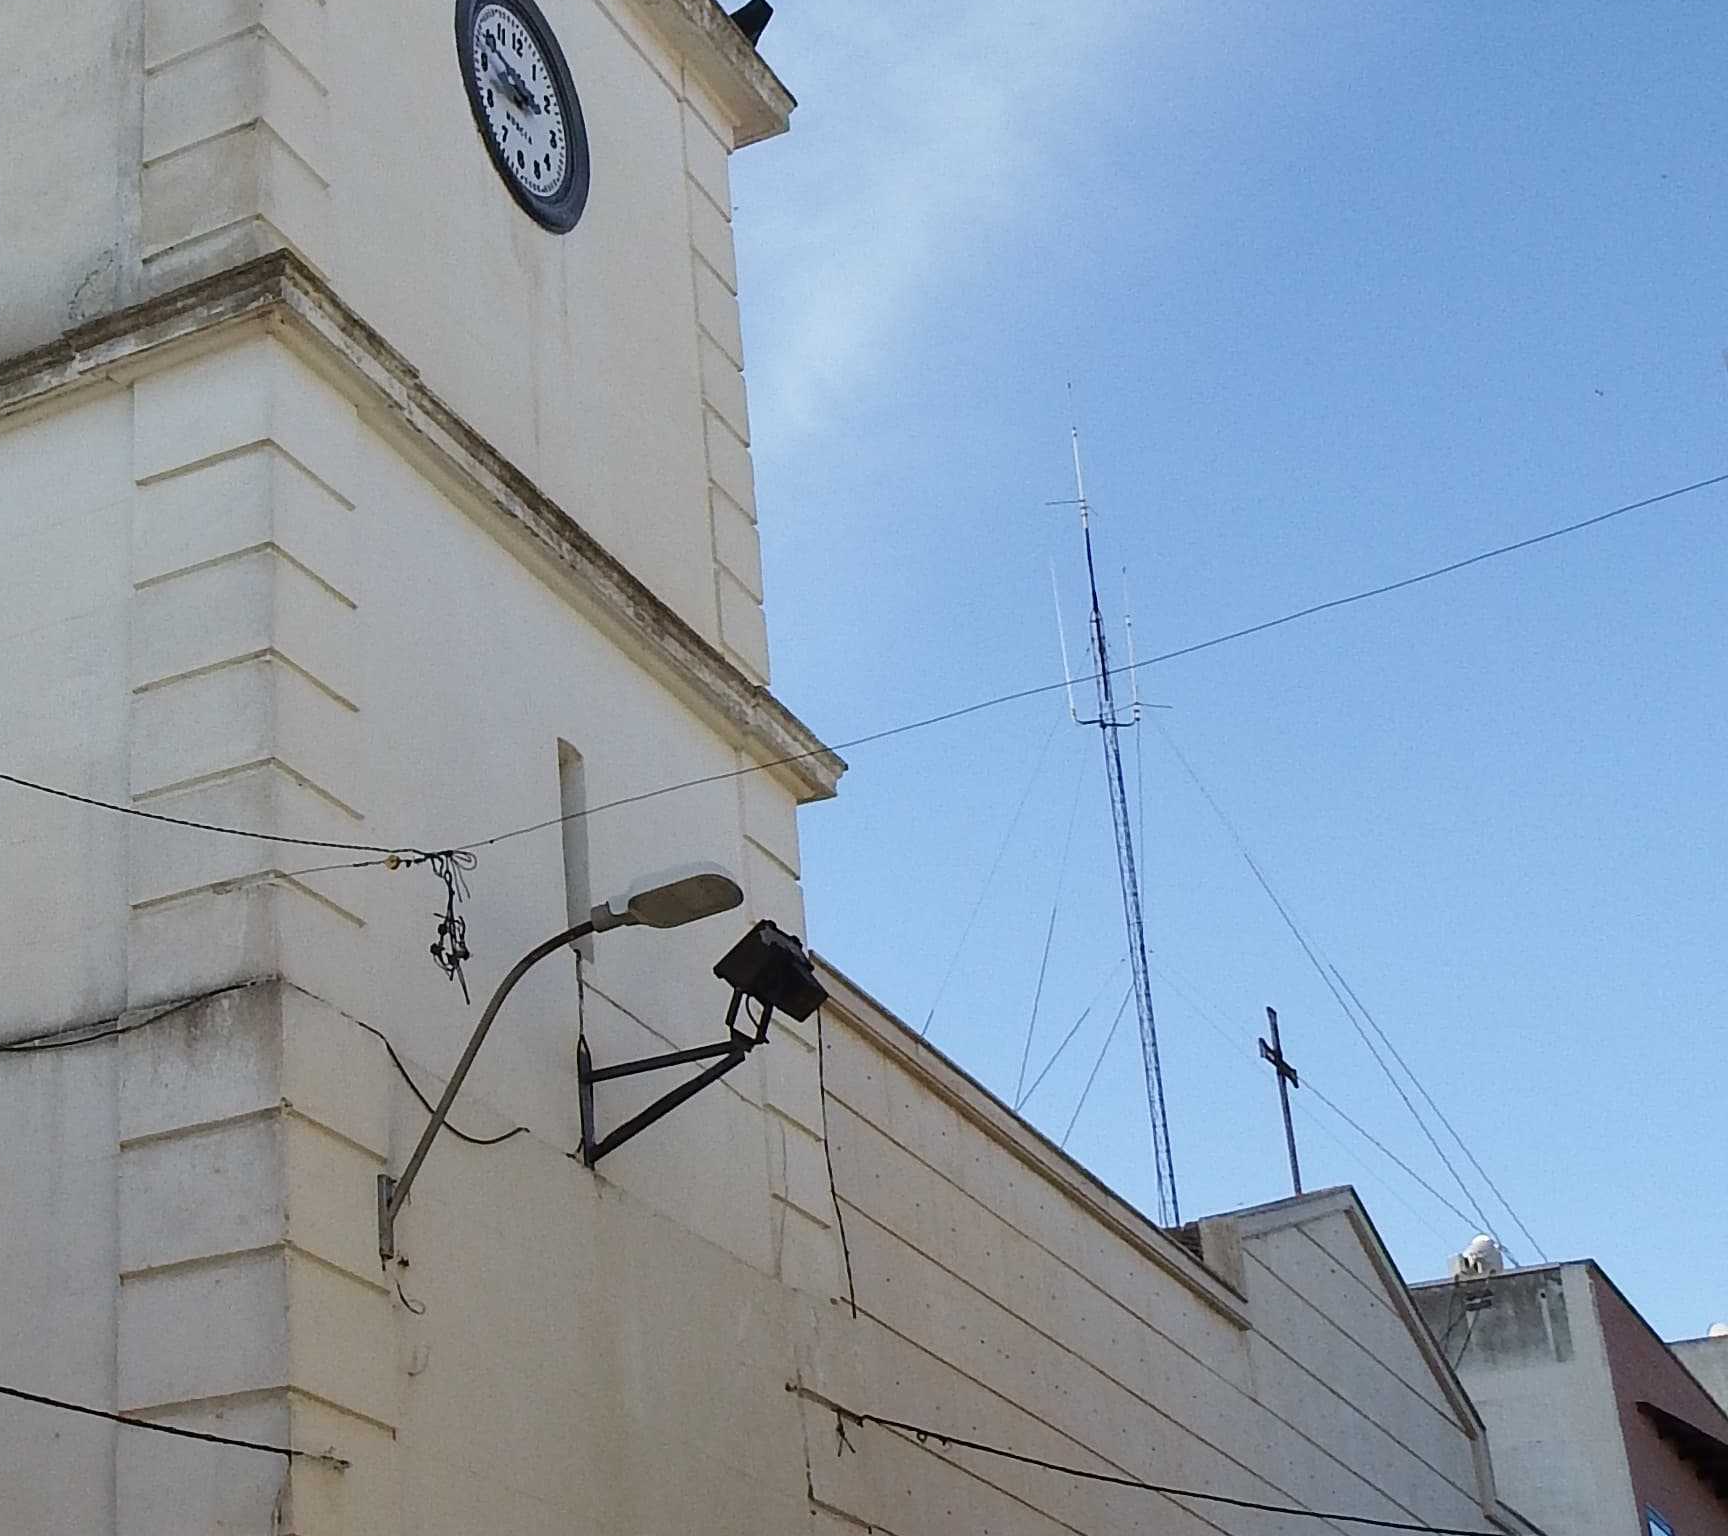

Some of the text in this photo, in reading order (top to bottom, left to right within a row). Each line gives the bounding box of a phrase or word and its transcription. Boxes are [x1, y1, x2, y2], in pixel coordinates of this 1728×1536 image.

[497, 22, 506, 46] 11
[512, 32, 523, 58] 12
[532, 63, 537, 82] 1
[543, 95, 551, 115] 2
[502, 125, 508, 143] 7
